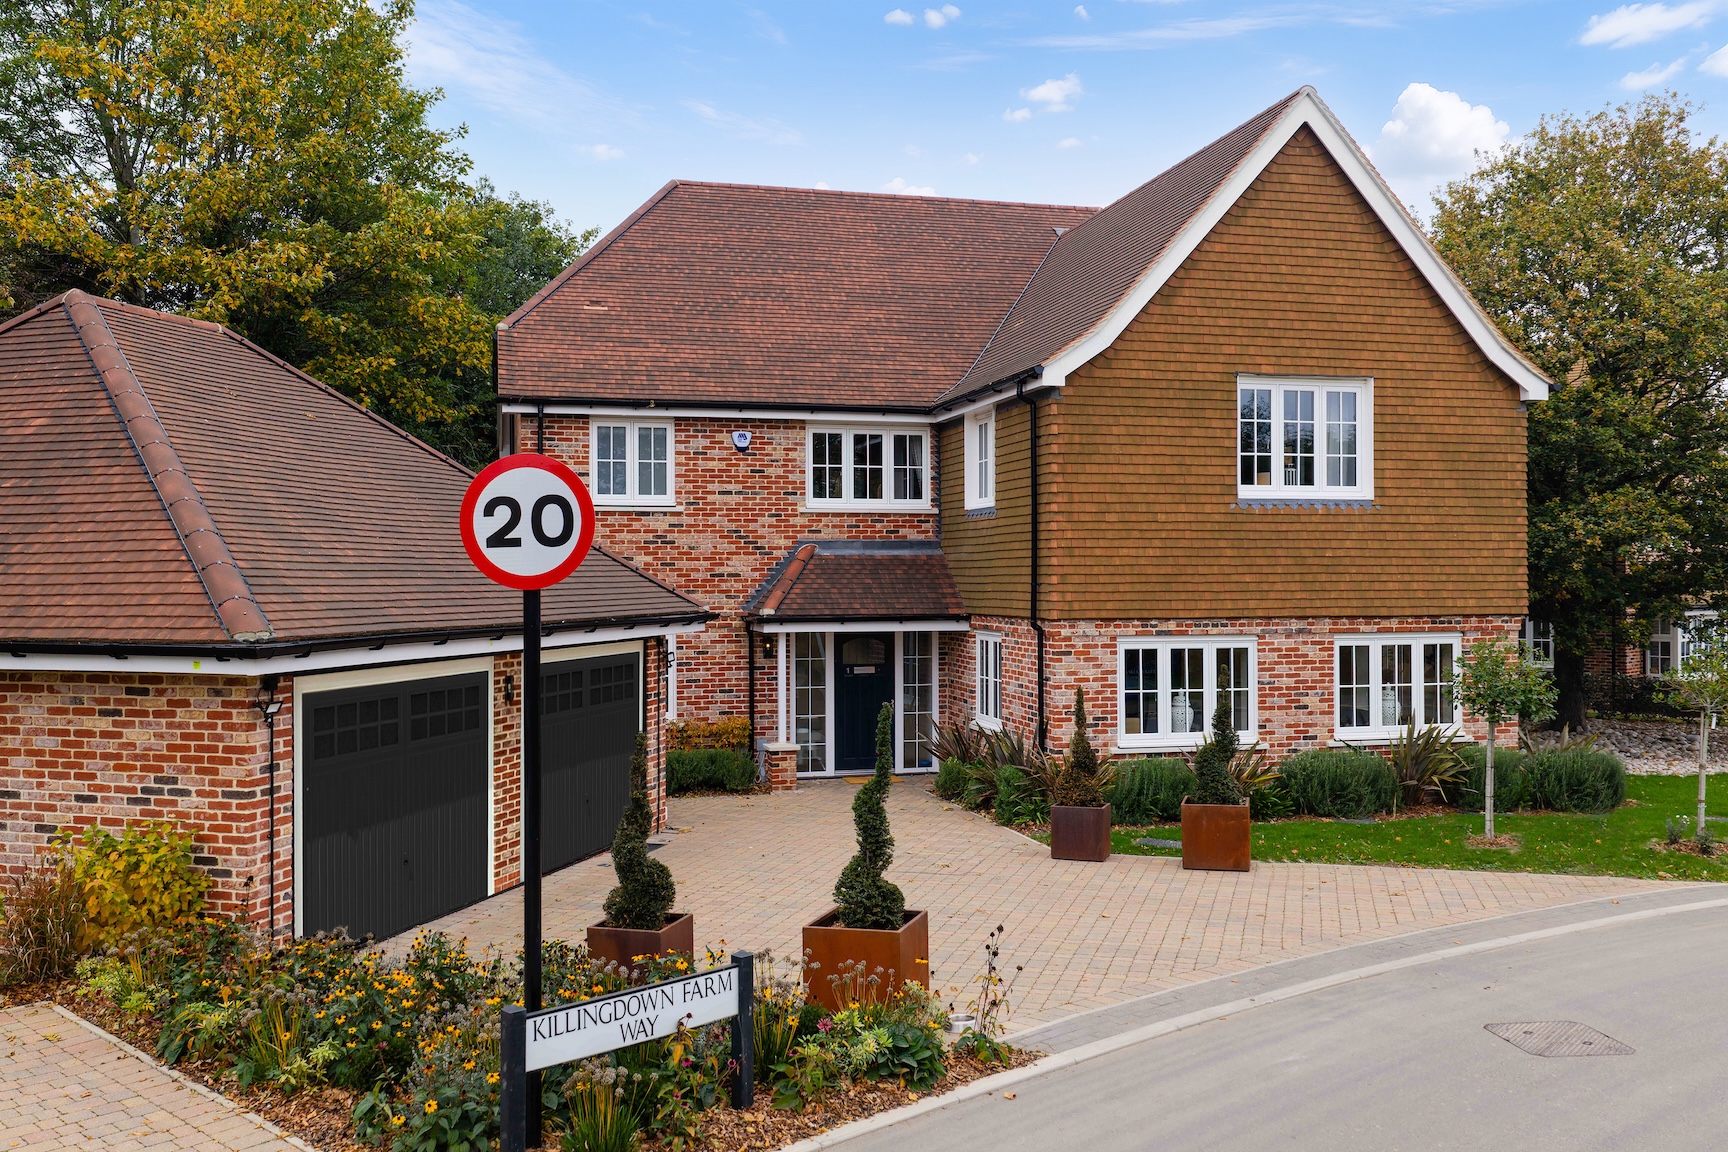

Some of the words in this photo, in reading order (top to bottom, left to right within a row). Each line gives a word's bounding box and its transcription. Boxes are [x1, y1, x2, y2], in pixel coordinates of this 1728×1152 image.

[483, 494, 574, 548] 20
[532, 986, 674, 1042] KILLINGDOWN
[682, 971, 733, 1003] FARM
[619, 1014, 660, 1043] WAY
